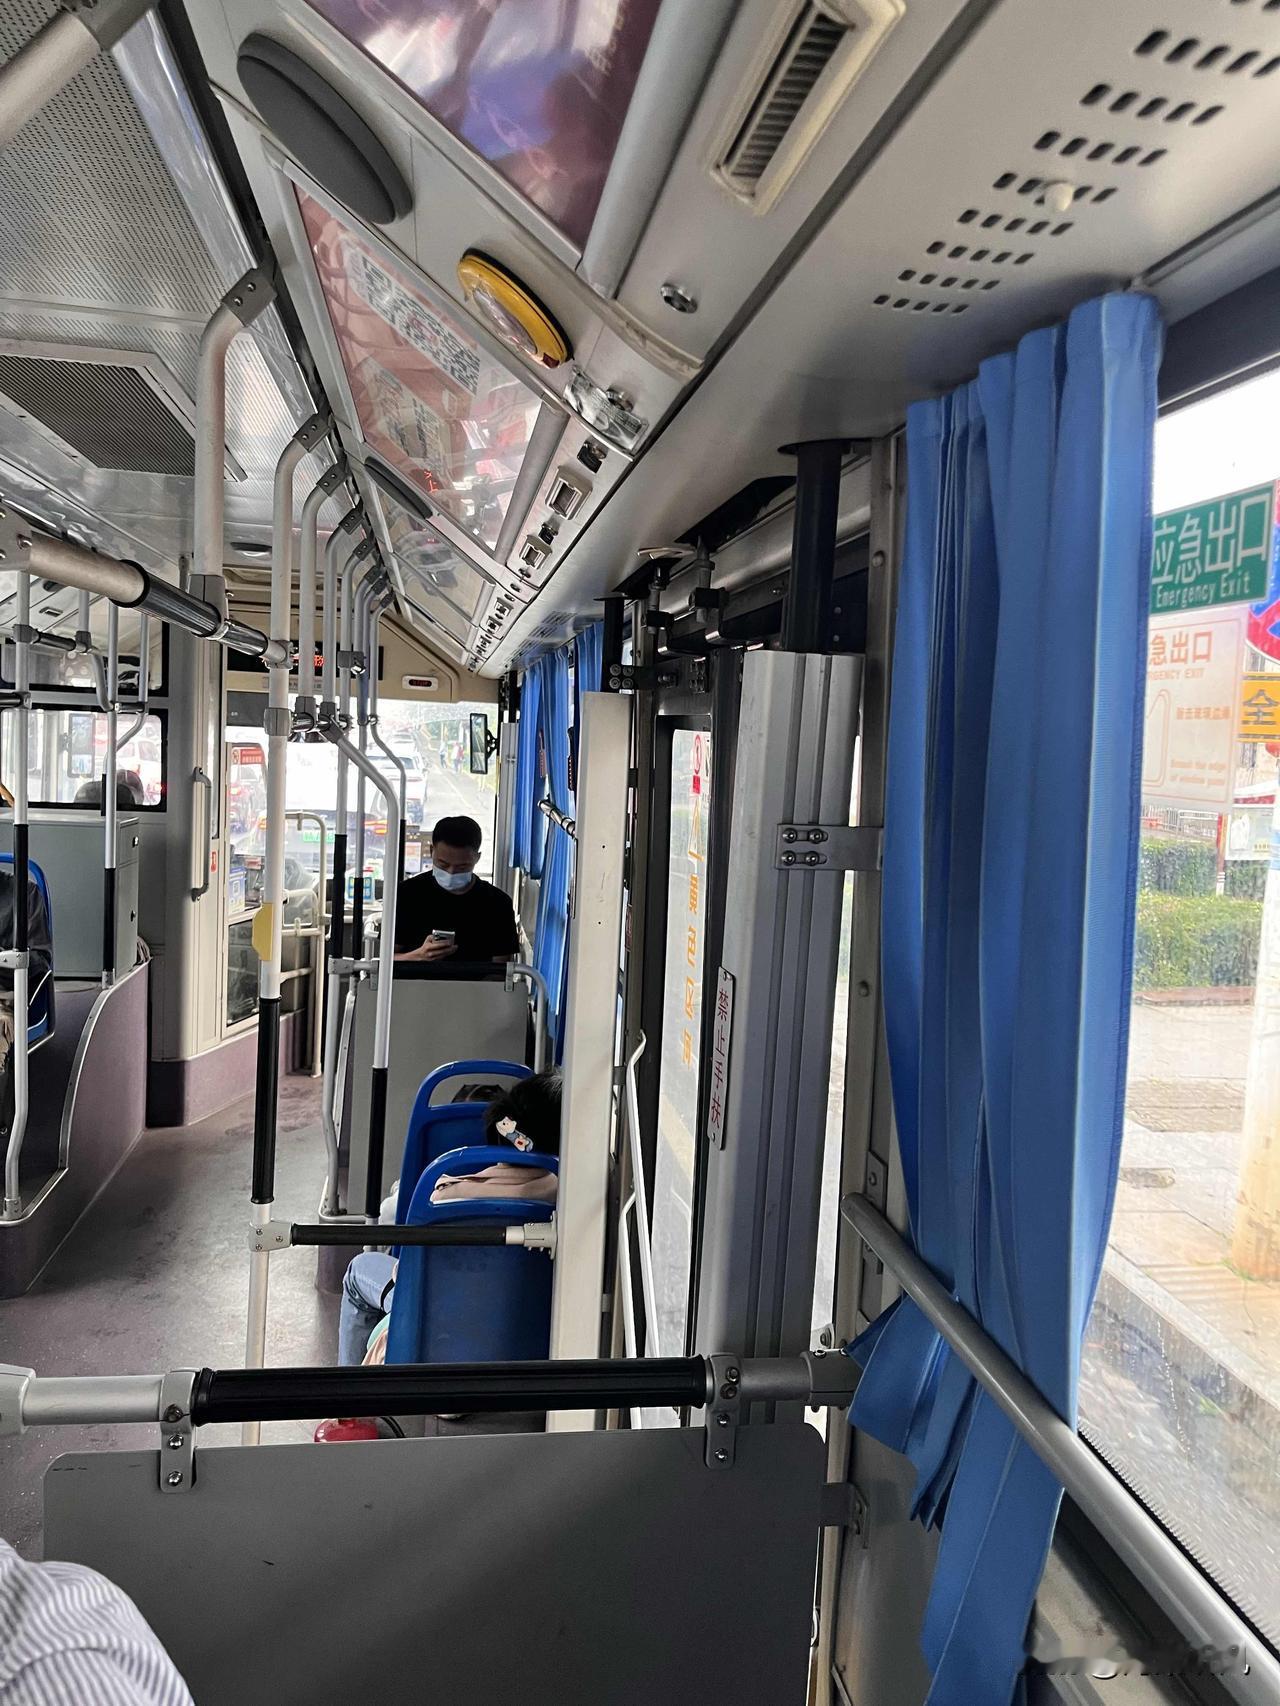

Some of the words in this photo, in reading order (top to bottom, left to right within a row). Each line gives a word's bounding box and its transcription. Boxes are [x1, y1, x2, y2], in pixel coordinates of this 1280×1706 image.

[1150, 493, 1271, 586] 应急出口
[1156, 583, 1217, 609] Emergency
[1220, 570, 1250, 598] Exit
[1149, 630, 1212, 666] 急出口
[1242, 687, 1279, 725] 全
[710, 987, 730, 1130] 禁止手扶
